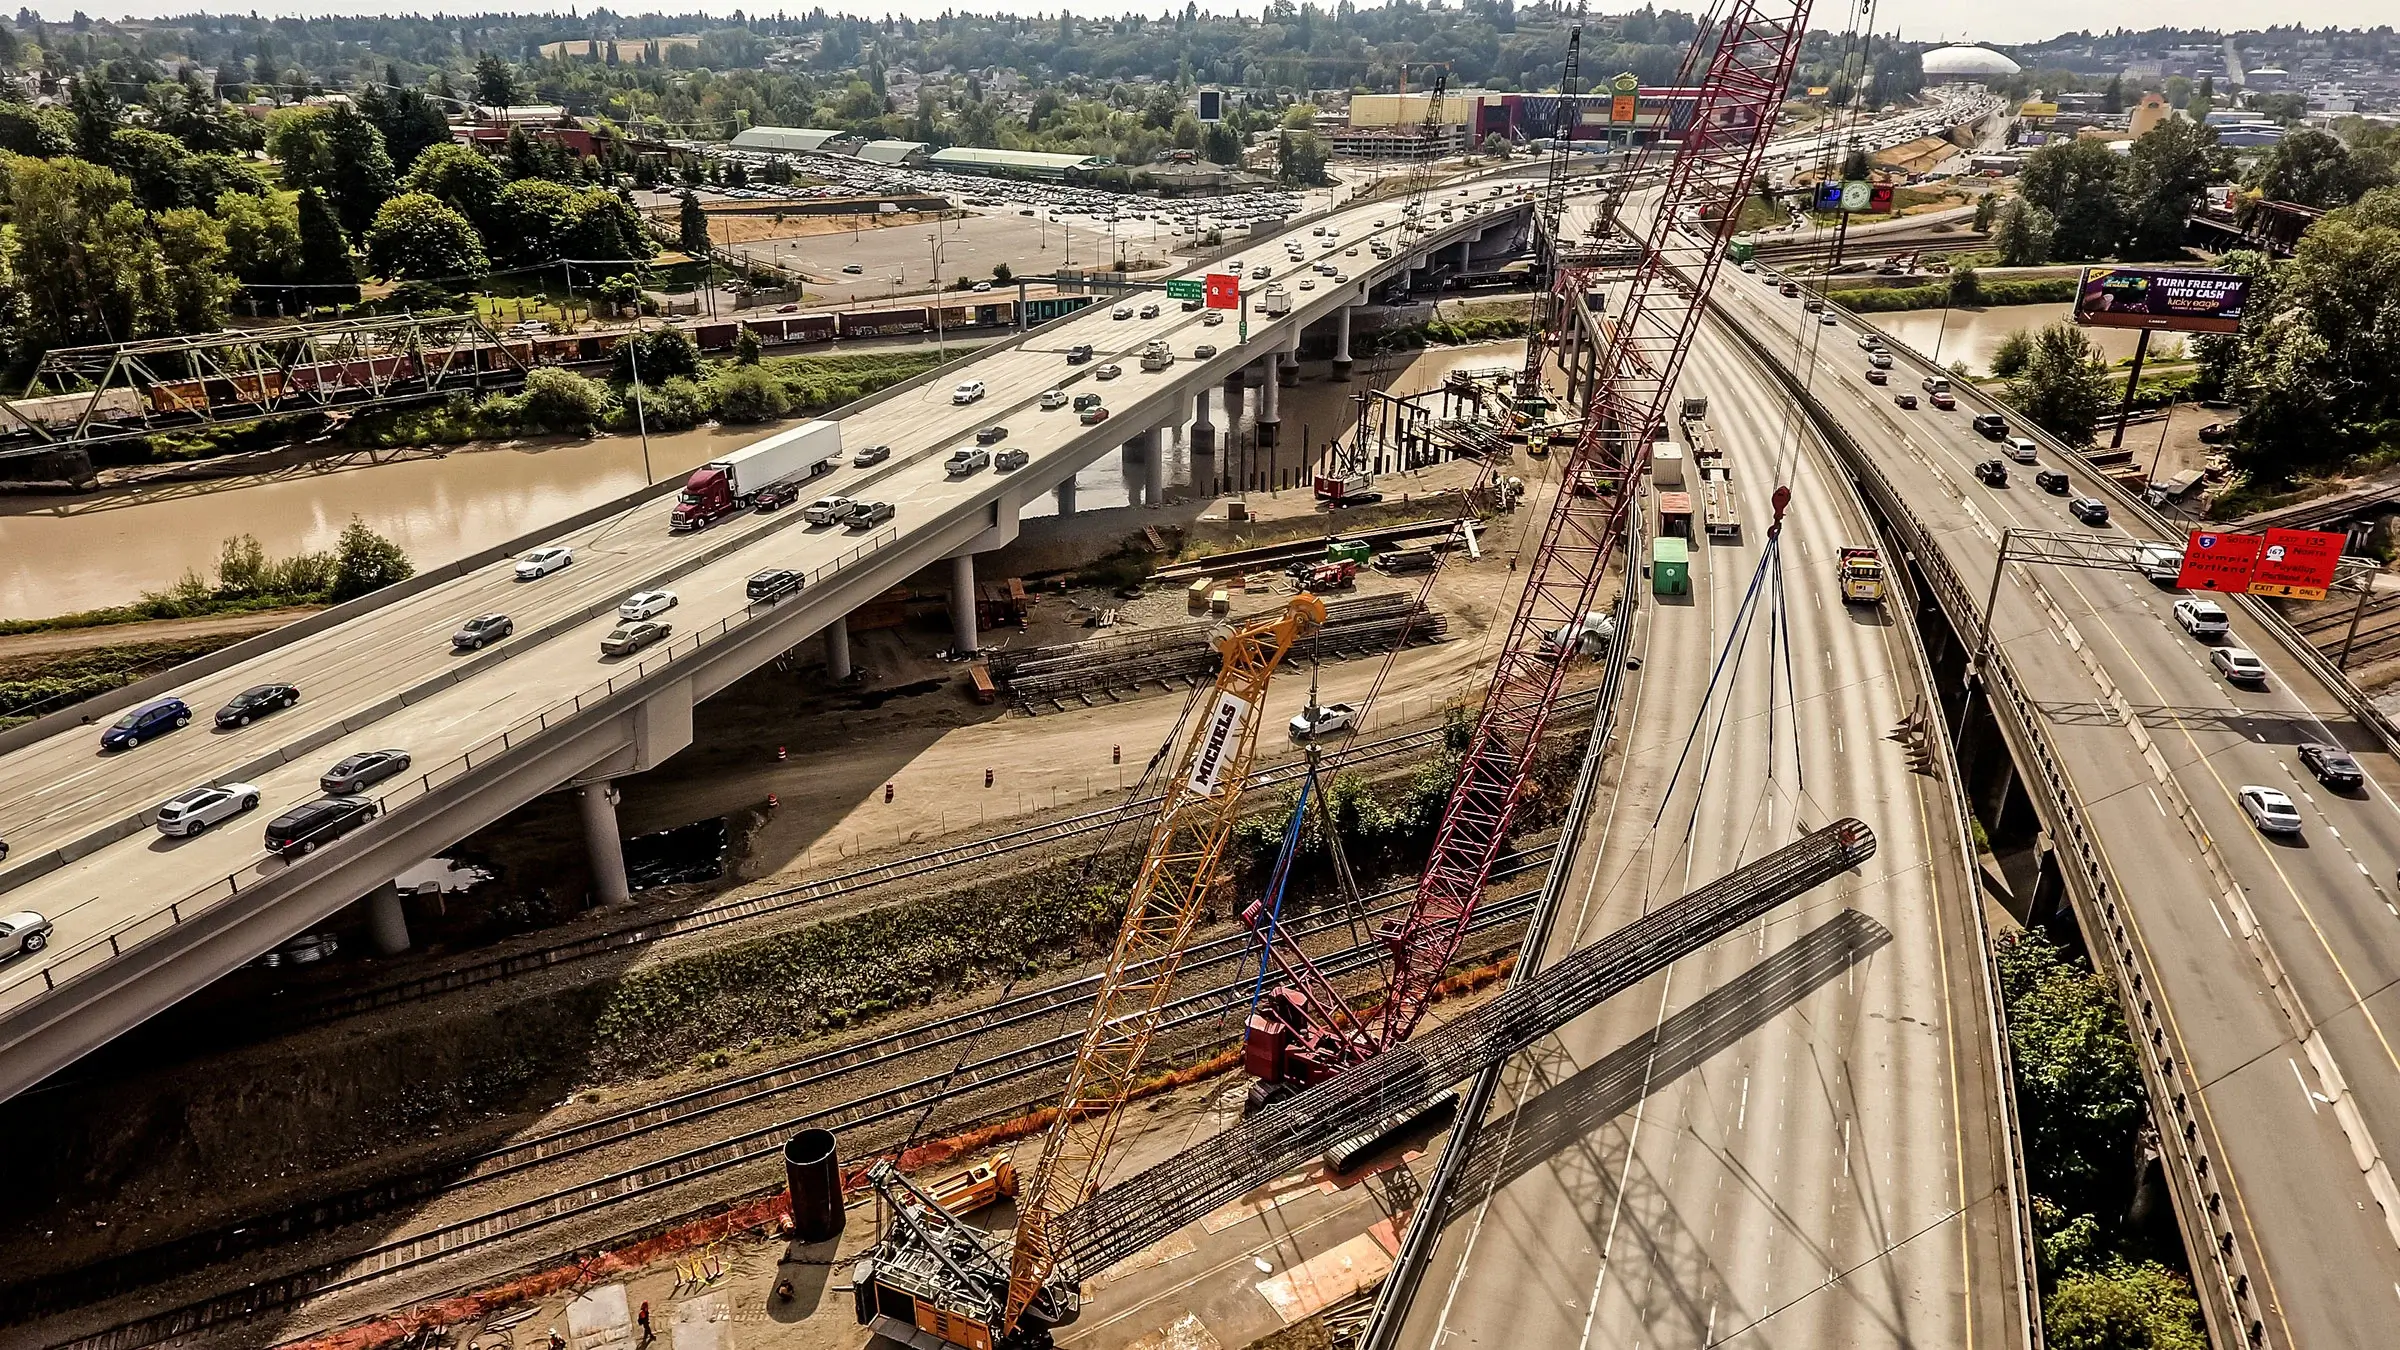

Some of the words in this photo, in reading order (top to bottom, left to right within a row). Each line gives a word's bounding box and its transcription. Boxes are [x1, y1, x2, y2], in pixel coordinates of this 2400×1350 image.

[2090, 270, 2104, 279] NEW
[2156, 277, 2185, 287] TURN
[2187, 279, 2213, 289] FREE
[2214, 281, 2243, 290] PLAY
[2166, 287, 2194, 297] INTO
[2195, 289, 2225, 299] CASH
[2167, 297, 2193, 307] lucky
[2192, 299, 2220, 310] eagle
[2203, 538, 2210, 547] 5
[2226, 535, 2258, 545] SOUTH
[2278, 535, 2299, 543] EXIT
[2306, 537, 2327, 546] 135
[2192, 551, 2249, 563] Olympia
[2292, 547, 2327, 557] NORTH
[2188, 561, 2247, 574] Portland
[2273, 562, 2316, 574] Puyallup
[2260, 572, 2301, 582] Portland
[2304, 576, 2321, 584] Ave
[2299, 588, 2322, 597] ONLY
[1194, 702, 1237, 787] MICHELS
